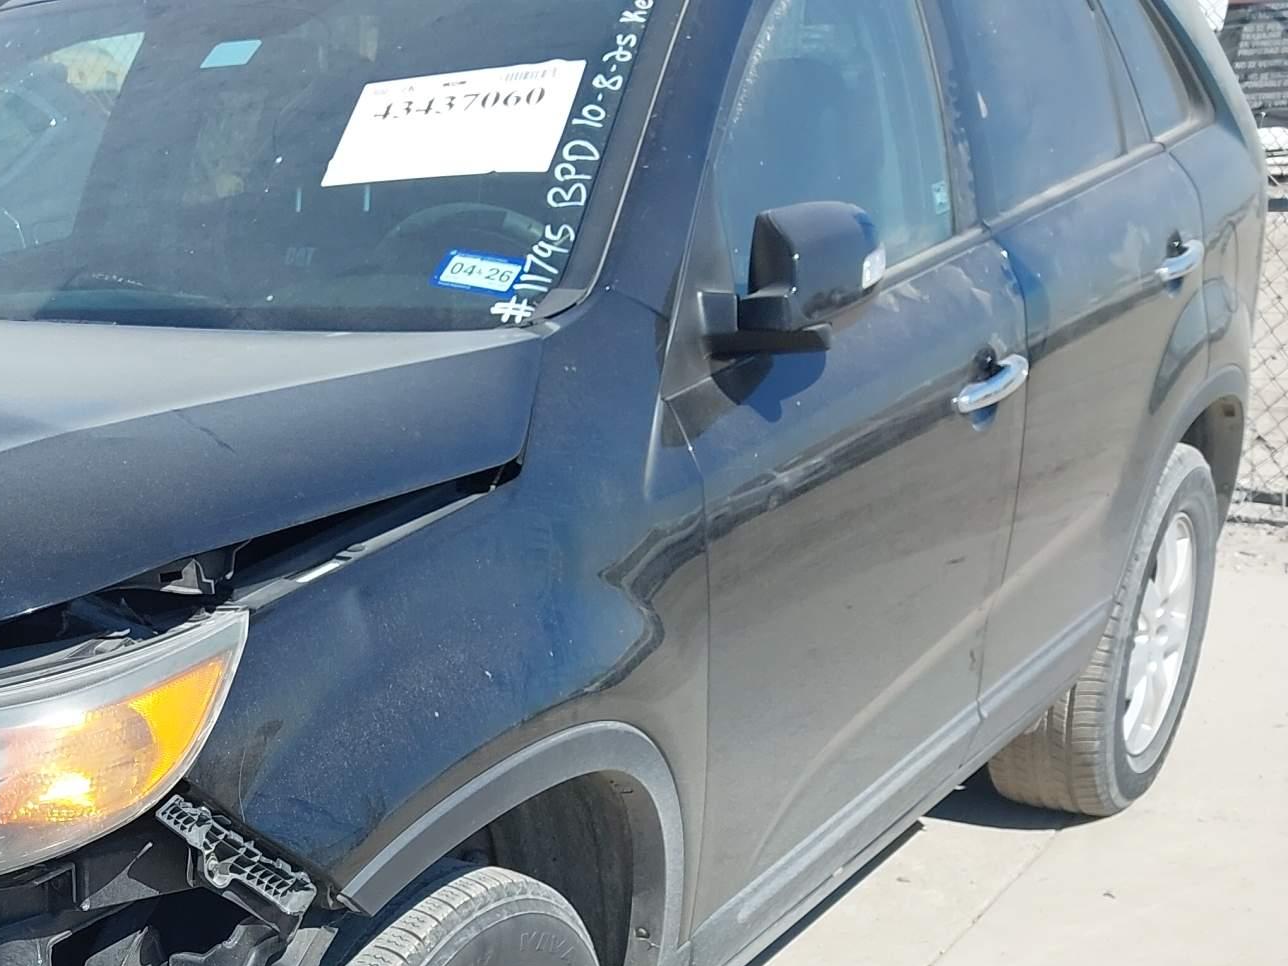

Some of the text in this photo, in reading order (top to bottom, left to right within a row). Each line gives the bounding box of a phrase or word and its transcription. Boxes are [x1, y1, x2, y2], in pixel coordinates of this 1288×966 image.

[373, 86, 546, 120] 43437060
[572, 33, 637, 128] 10-8-25
[547, 139, 600, 207] BPD
